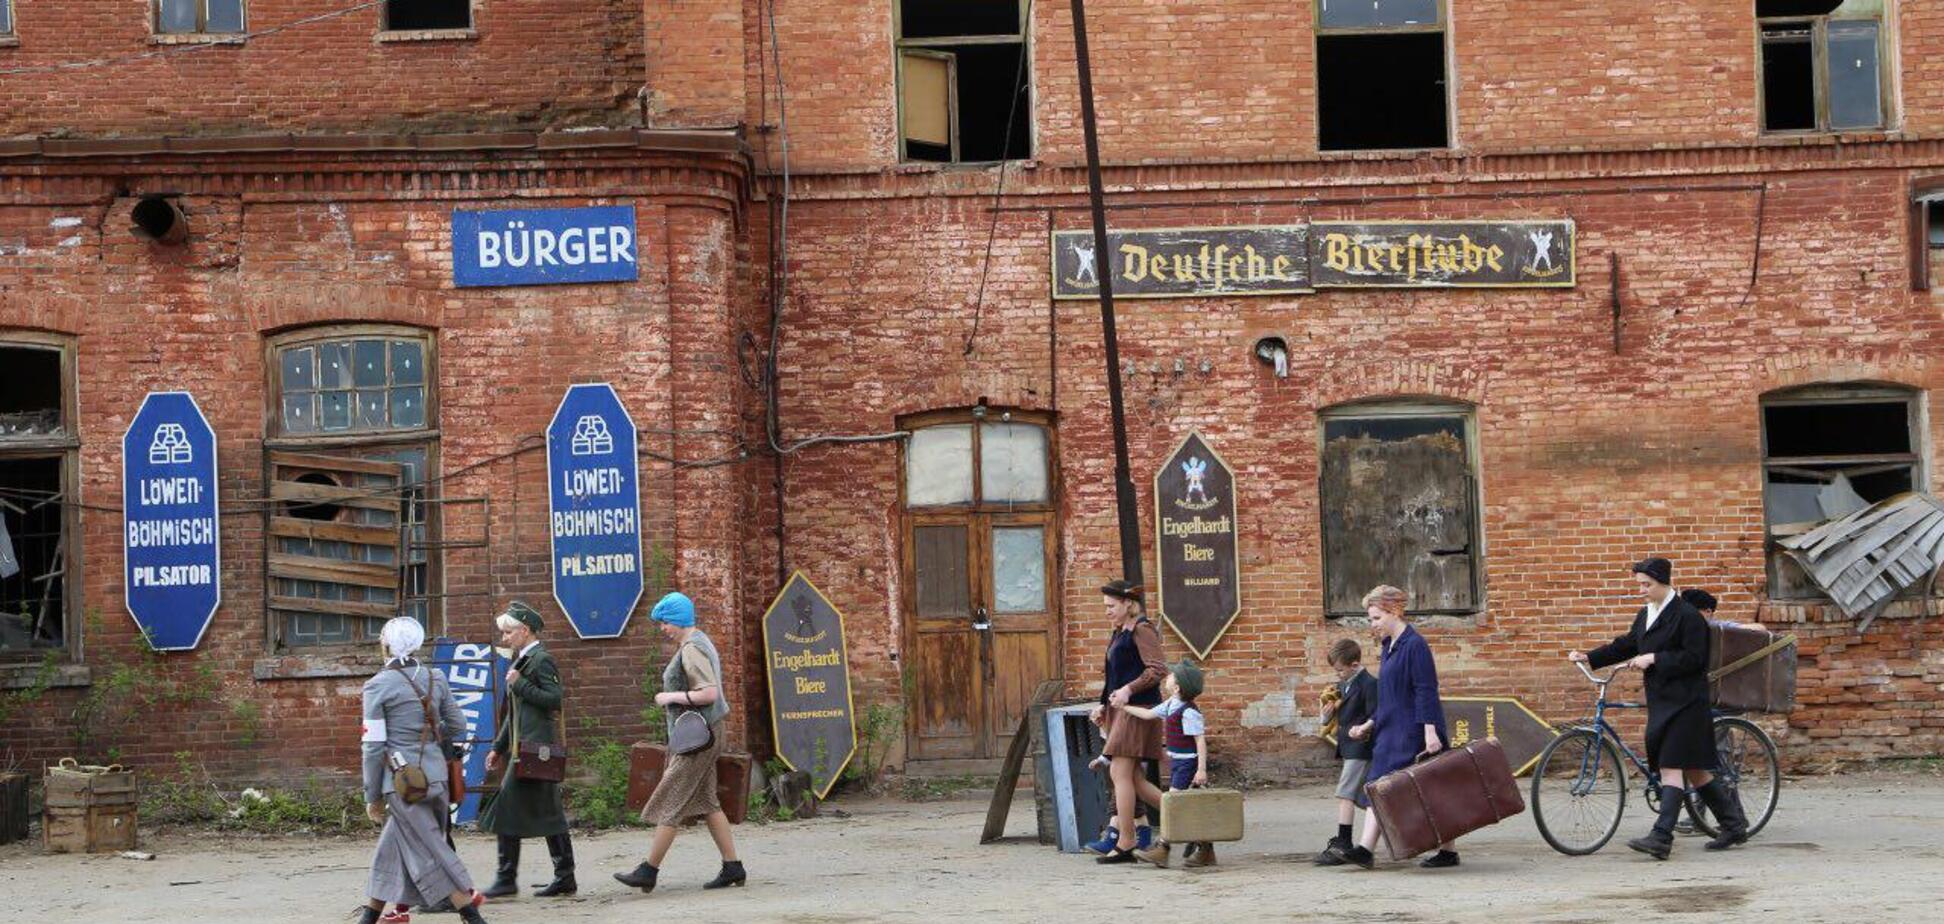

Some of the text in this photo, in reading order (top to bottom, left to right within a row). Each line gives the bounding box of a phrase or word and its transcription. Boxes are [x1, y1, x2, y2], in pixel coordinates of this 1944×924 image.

[478, 220, 635, 268] BÜRGER
[1163, 516, 1231, 538] Engelhardt
[1183, 543, 1215, 562] Biere
[133, 564, 211, 587] PILSATOR
[561, 553, 636, 577] PILSATOR
[773, 649, 840, 671] Engelhardt
[795, 677, 826, 695] Biere
